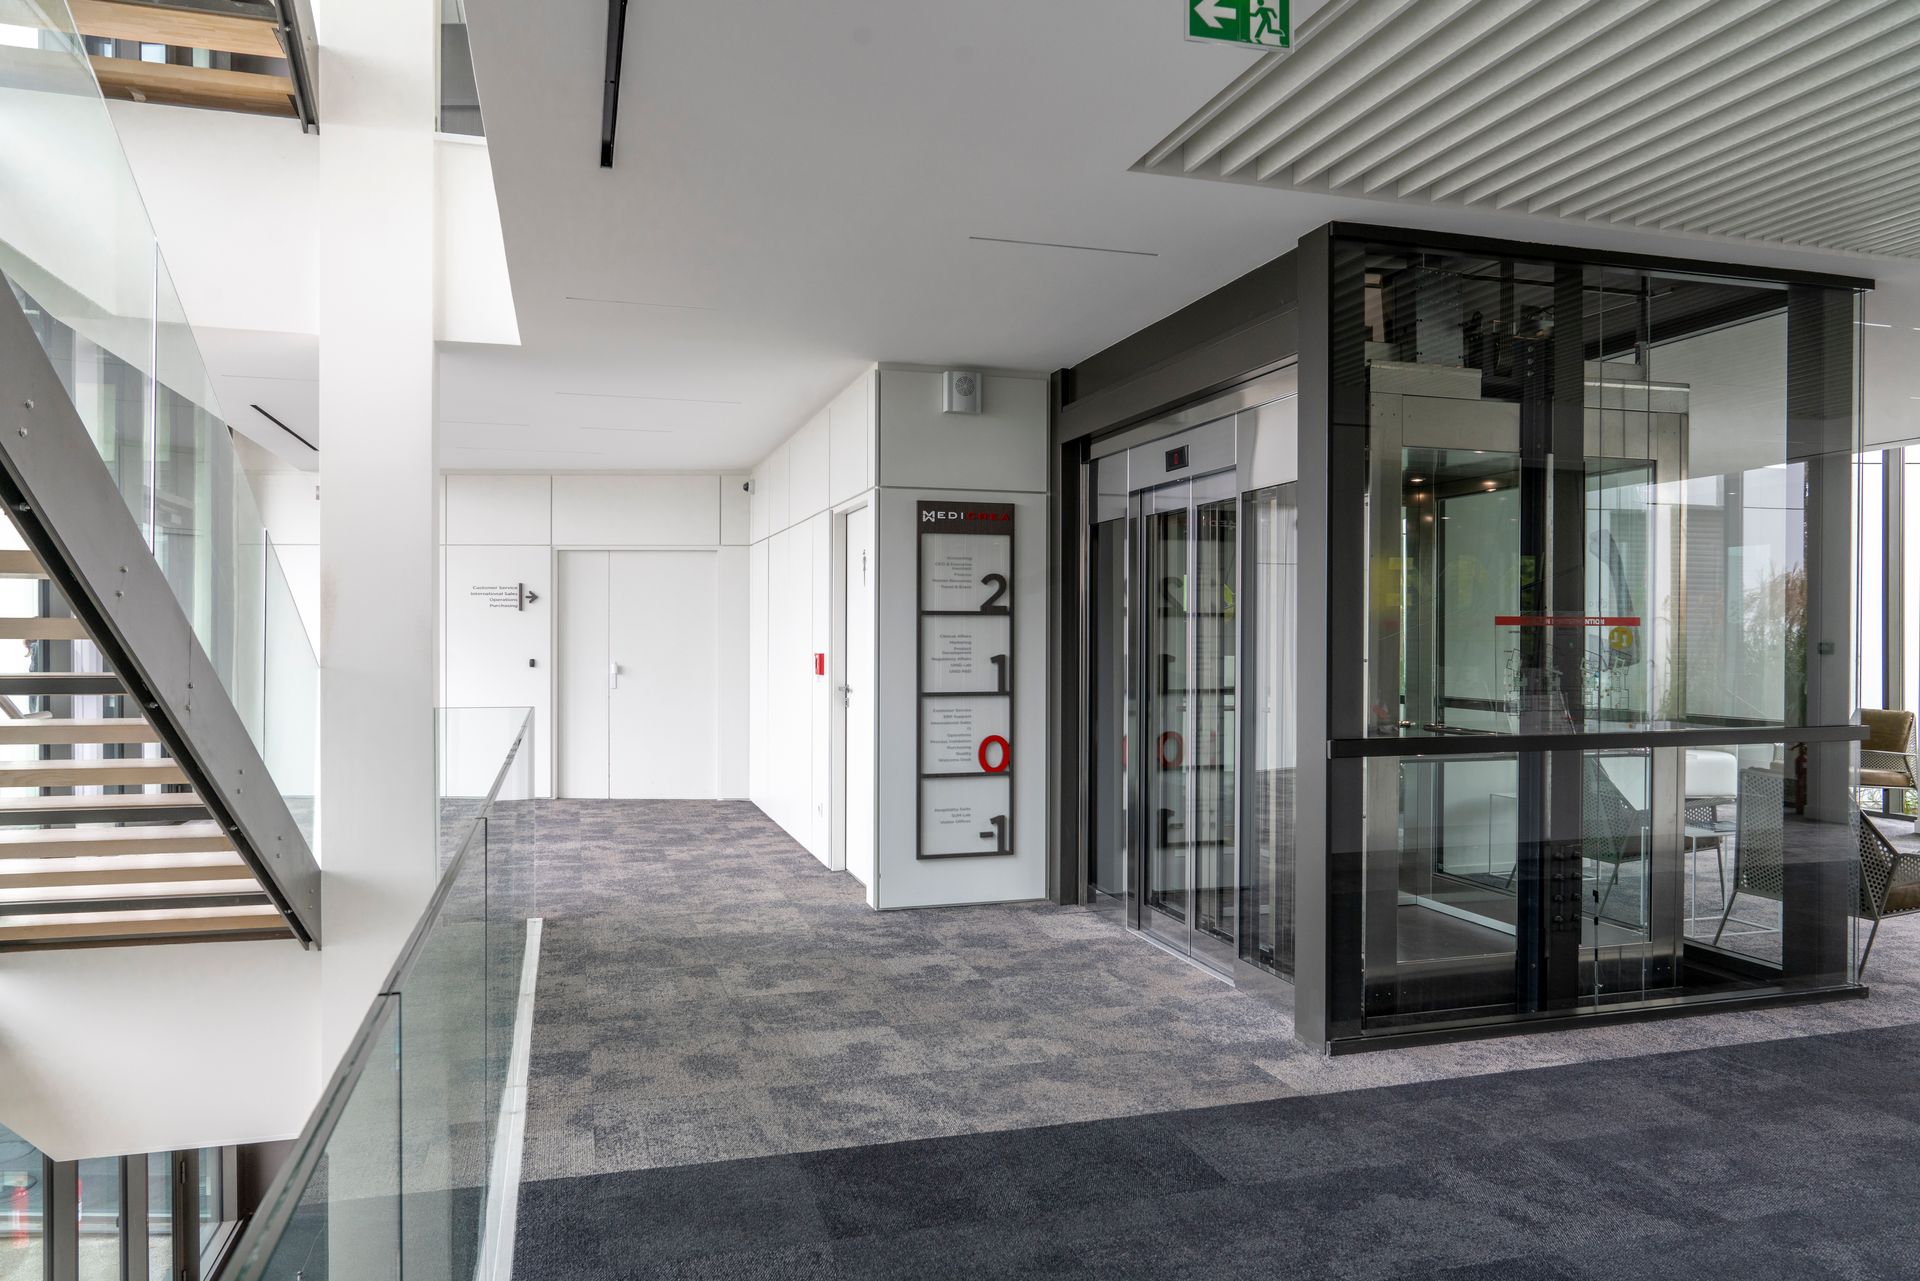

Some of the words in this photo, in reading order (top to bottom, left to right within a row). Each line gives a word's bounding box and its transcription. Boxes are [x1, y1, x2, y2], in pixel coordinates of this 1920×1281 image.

[980, 573, 1008, 613] 2
[990, 654, 1006, 693] 1
[979, 815, 1006, 854] -1
